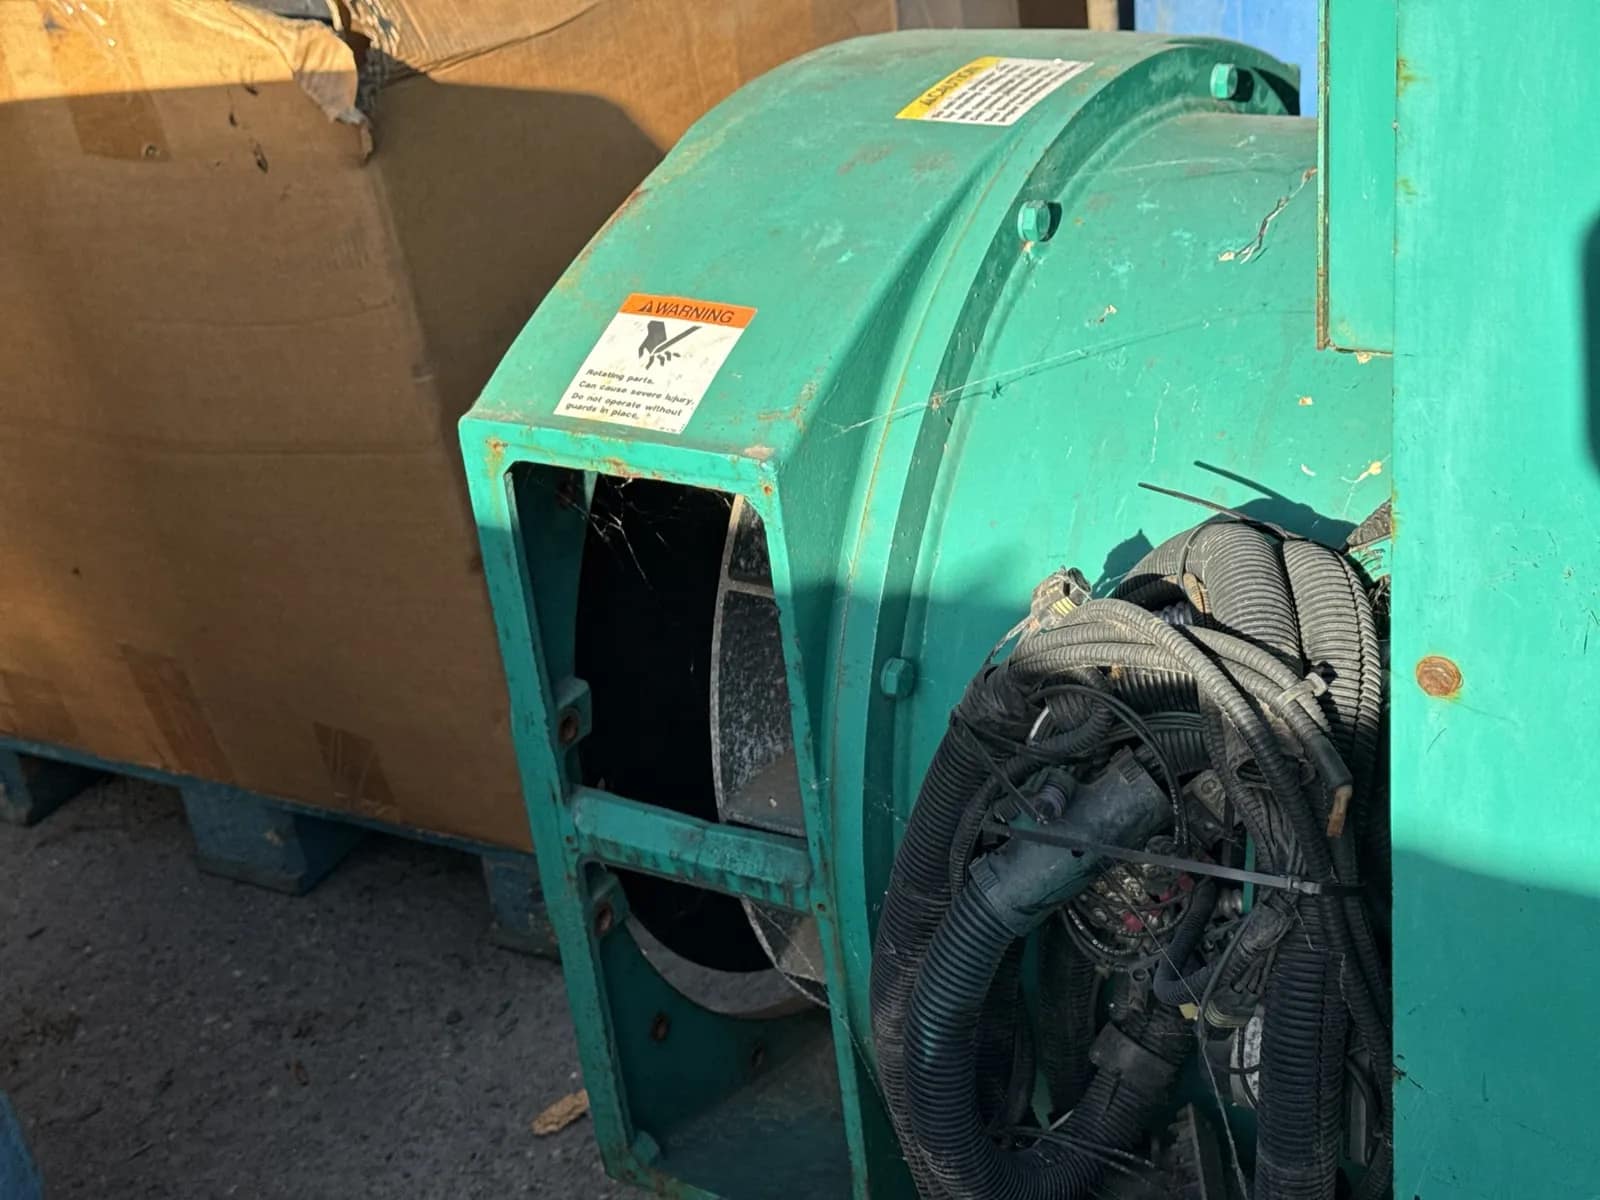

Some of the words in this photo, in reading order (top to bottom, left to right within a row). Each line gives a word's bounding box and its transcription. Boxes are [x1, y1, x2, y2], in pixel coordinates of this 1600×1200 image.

[655, 301, 735, 323] WARNING
[586, 368, 625, 381] Rotating
[626, 375, 655, 385] parts.
[579, 380, 597, 389] Can
[599, 384, 627, 393] cause
[630, 389, 662, 399] severe
[565, 402, 597, 413] guards
[600, 405, 609, 414] in
[571, 392, 585, 401] Do
[586, 395, 603, 403] not
[604, 398, 641, 409] operate
[645, 404, 682, 417] without
